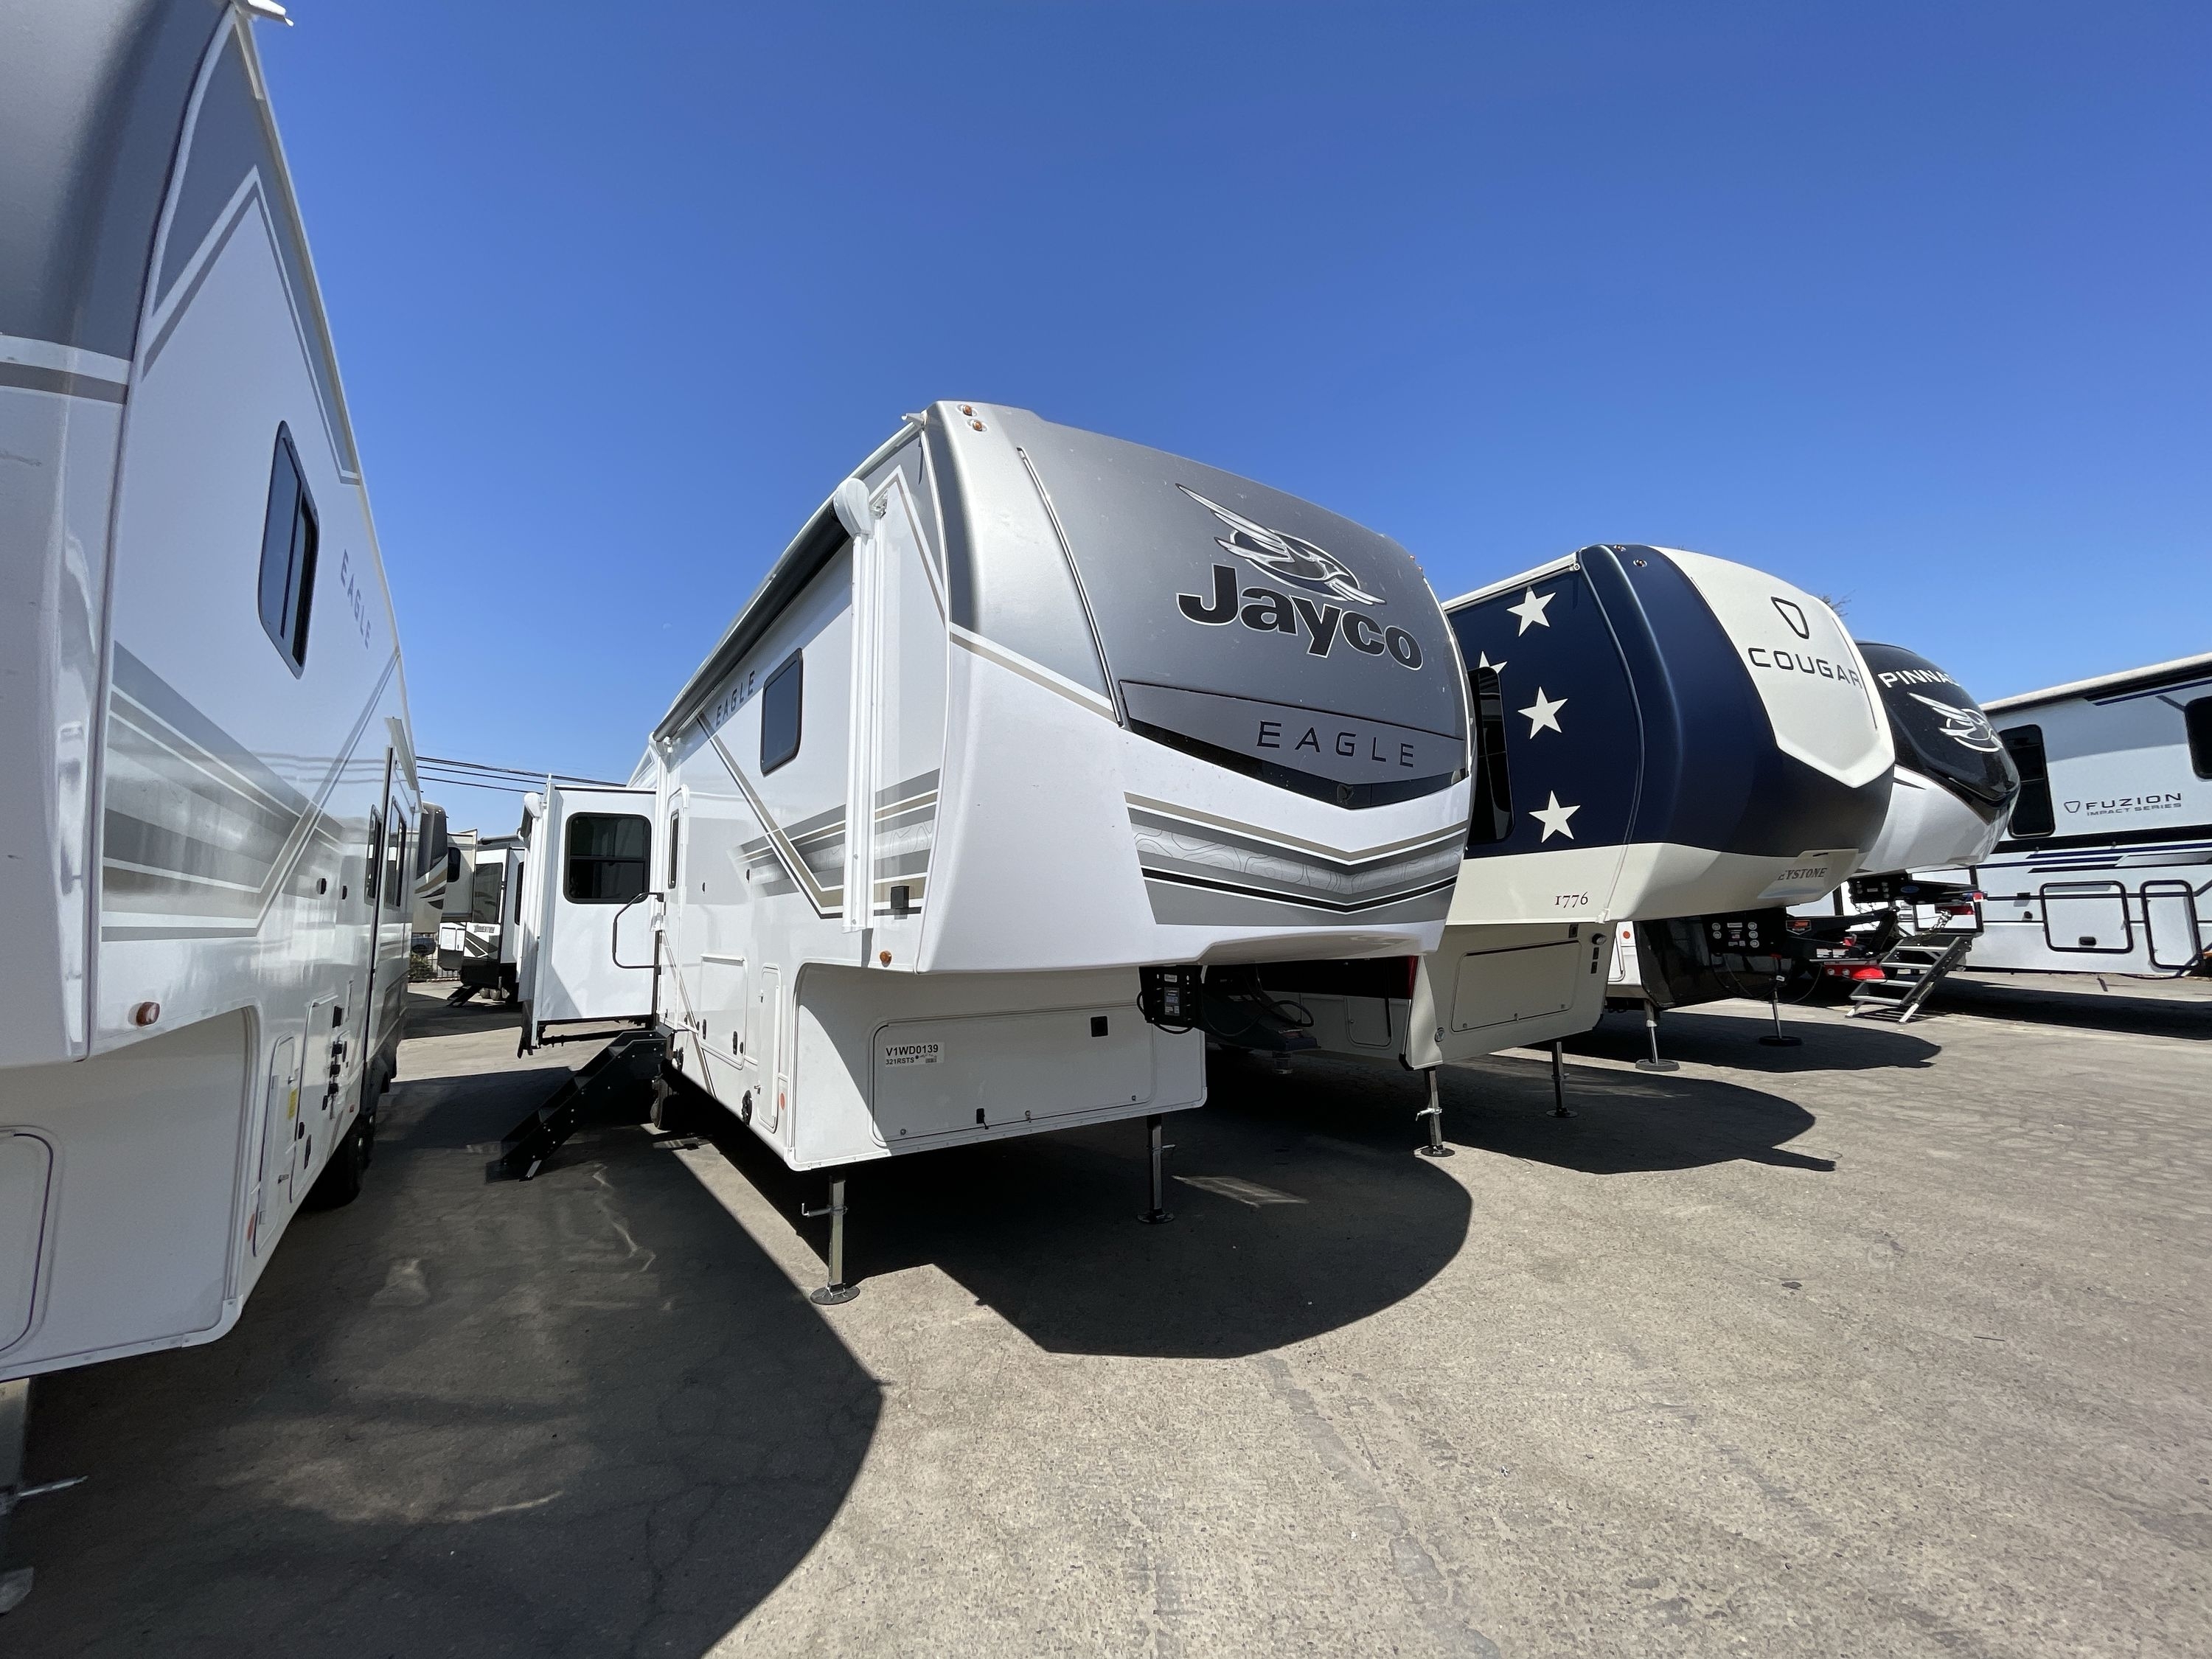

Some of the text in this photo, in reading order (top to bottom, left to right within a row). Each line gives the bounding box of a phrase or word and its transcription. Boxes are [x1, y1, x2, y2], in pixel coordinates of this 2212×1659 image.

[341, 549, 371, 650] EAGLE
[1176, 563, 1422, 670] Jayco
[1748, 647, 1863, 689] COUGAR
[714, 669, 755, 726] EAGLE
[1256, 720, 1414, 768] EAGLE
[2086, 793, 2182, 810] FUZION
[2087, 802, 2182, 816] IMPACT SERIES
[1554, 891, 1588, 908] 1776
[886, 1044, 939, 1057] V1WD0139
[886, 1057, 915, 1065] 321RSTS
